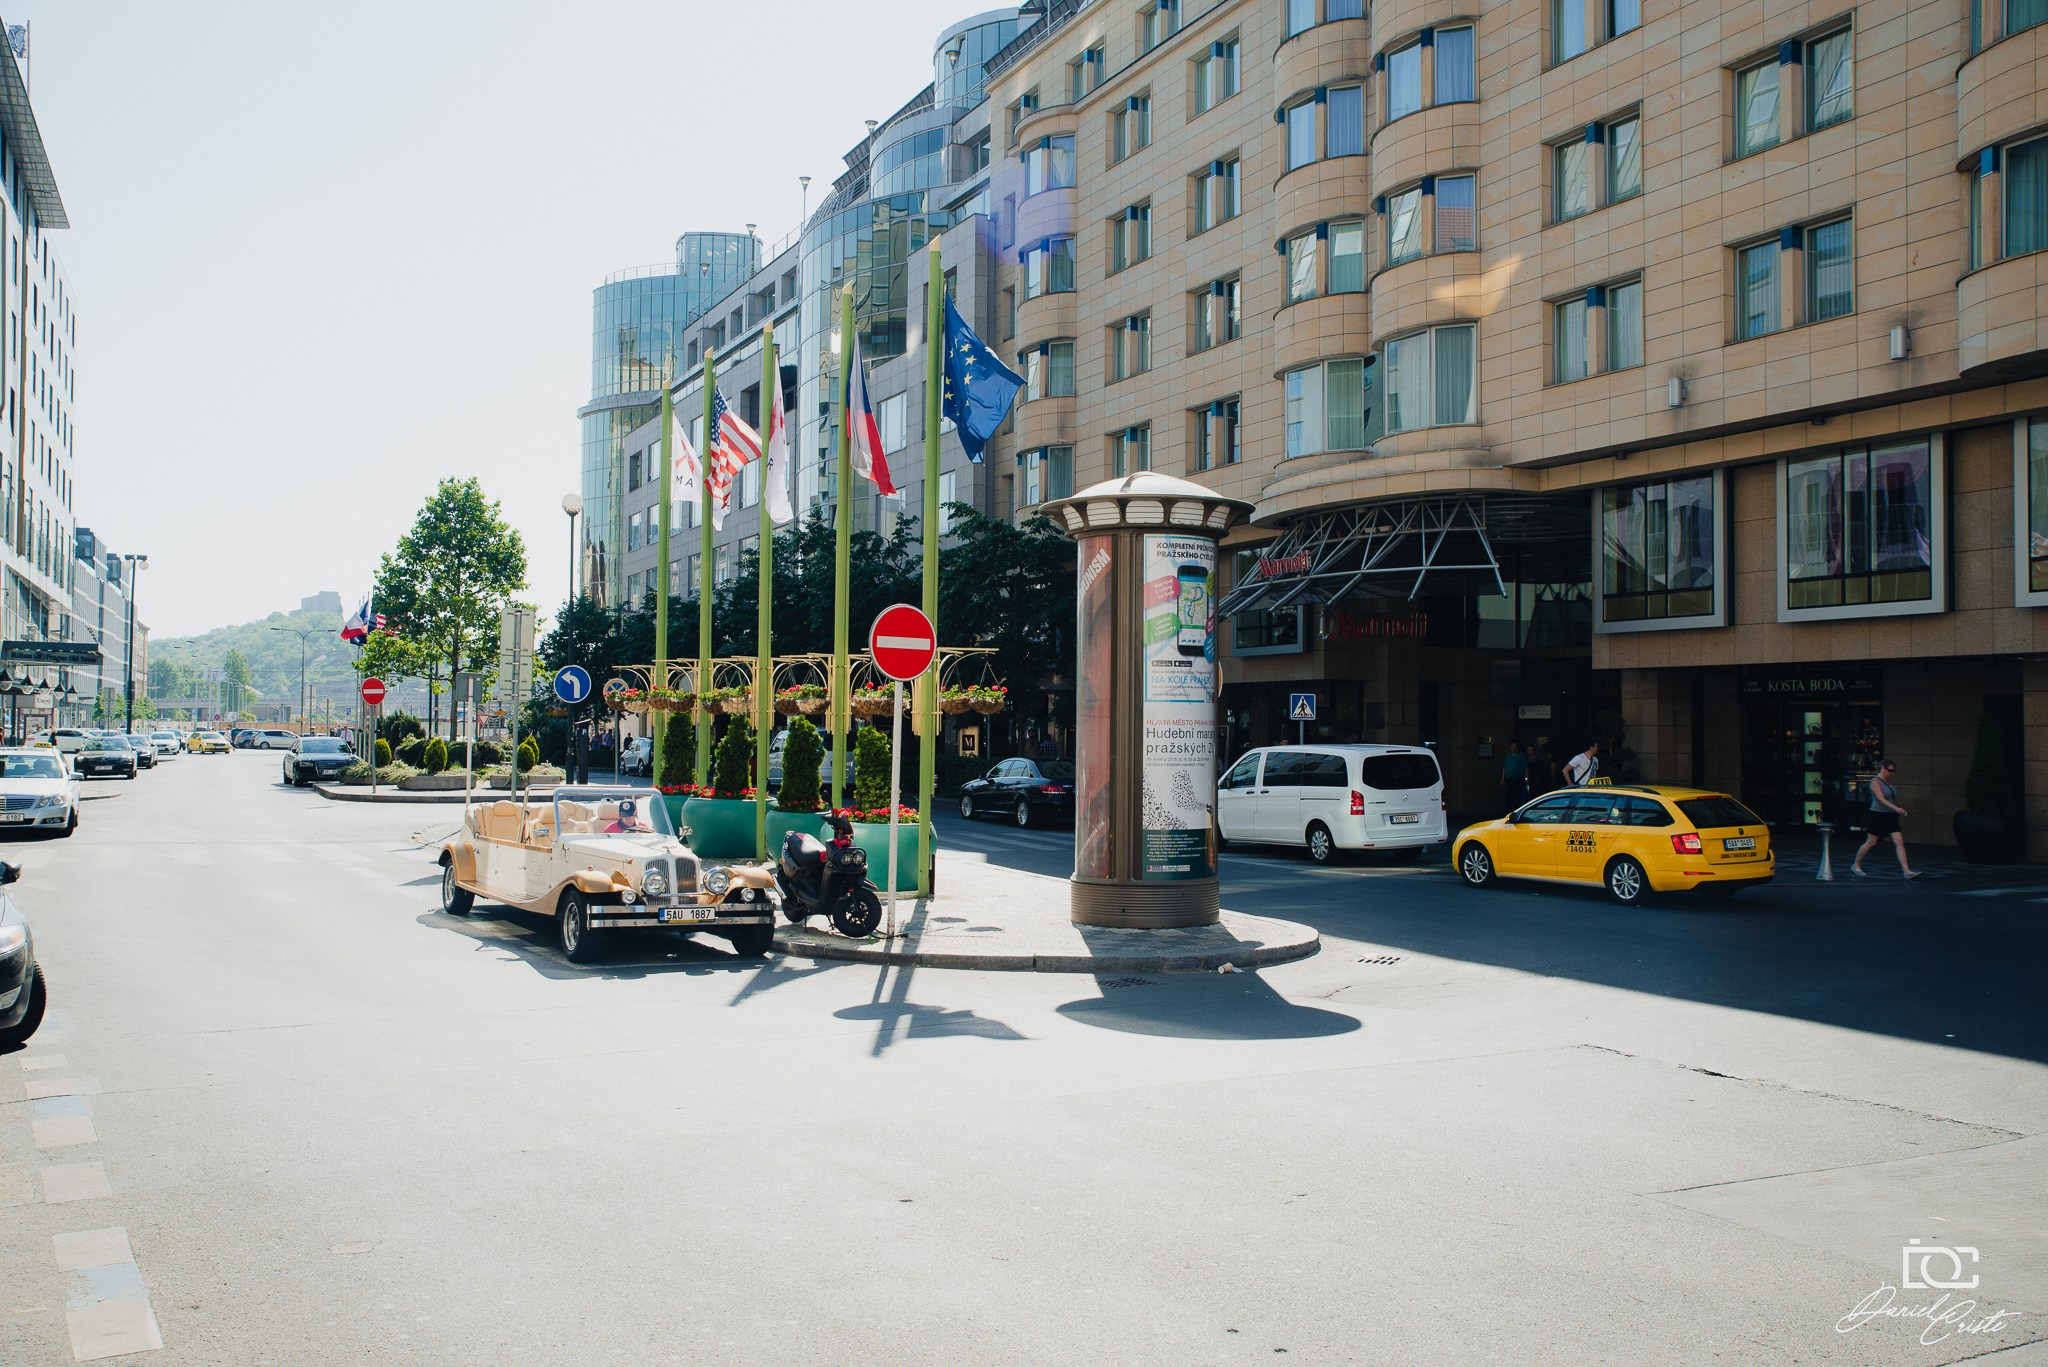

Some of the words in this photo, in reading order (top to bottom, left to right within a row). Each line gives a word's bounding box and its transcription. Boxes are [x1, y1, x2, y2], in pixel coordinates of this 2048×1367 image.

[1156, 541, 1196, 551] KOMPLETNÍ
[1156, 549, 1199, 560] PRAŽSKÉHO
[1256, 550, 1312, 581] Marriott
[1327, 611, 1429, 641] Marriott
[11, 651, 32, 659] Hilton
[45, 654, 67, 662] Prague
[1152, 675, 1166, 684] NA
[1168, 675, 1188, 684] KOLE
[1768, 679, 1805, 692] KOSTA
[1810, 678, 1844, 691] BODA
[1146, 718, 1171, 726] HLAVNÍ
[1172, 718, 1194, 726] MĚSTO
[1146, 727, 1195, 739] Hudební
[1146, 741, 1206, 757] pražských
[666, 909, 683, 920] 5AU
[690, 909, 712, 919] 1887
